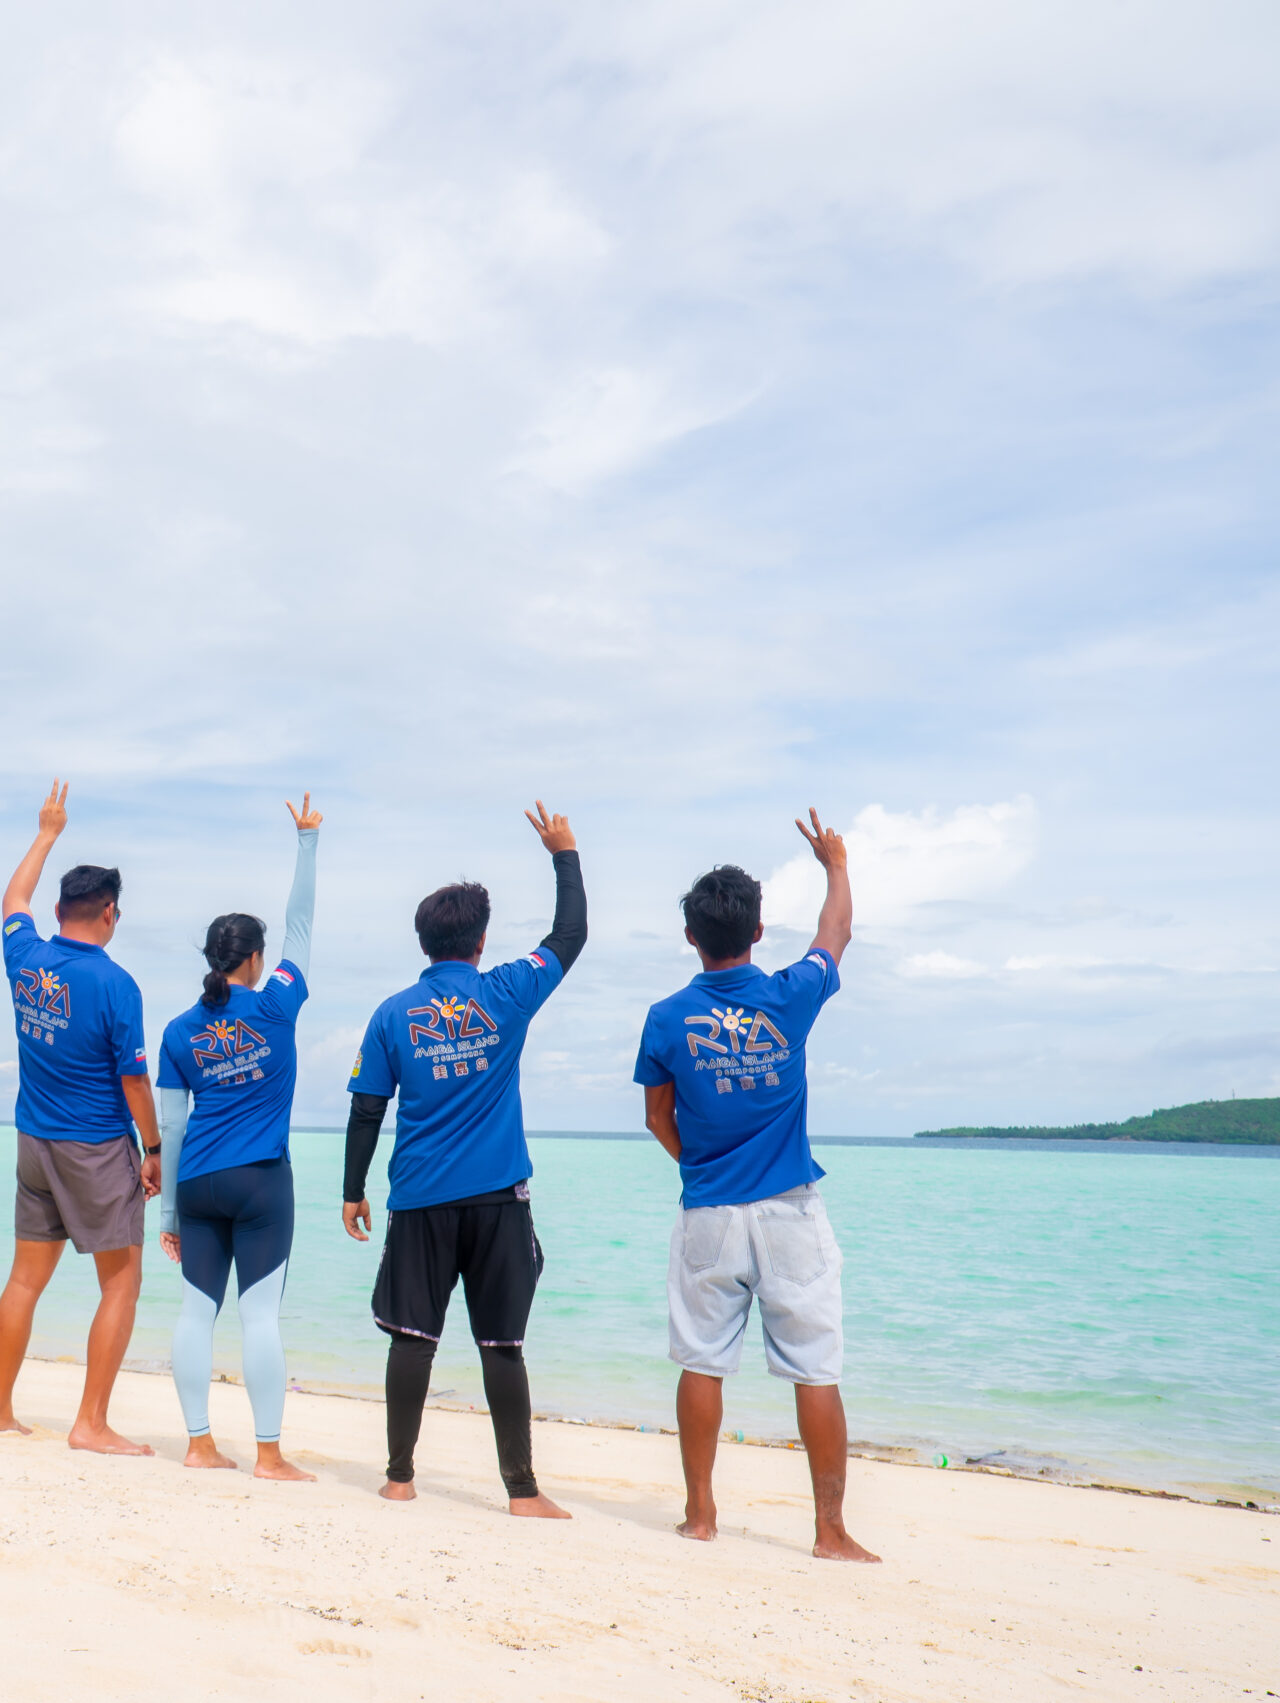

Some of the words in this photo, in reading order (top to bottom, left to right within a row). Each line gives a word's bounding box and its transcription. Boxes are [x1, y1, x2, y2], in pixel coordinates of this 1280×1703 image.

[414, 1043, 455, 1058] MAIGA
[457, 1034, 500, 1052] ISLAND
[695, 1056, 739, 1071] MAIGA
[742, 1049, 790, 1066] ISLAND
